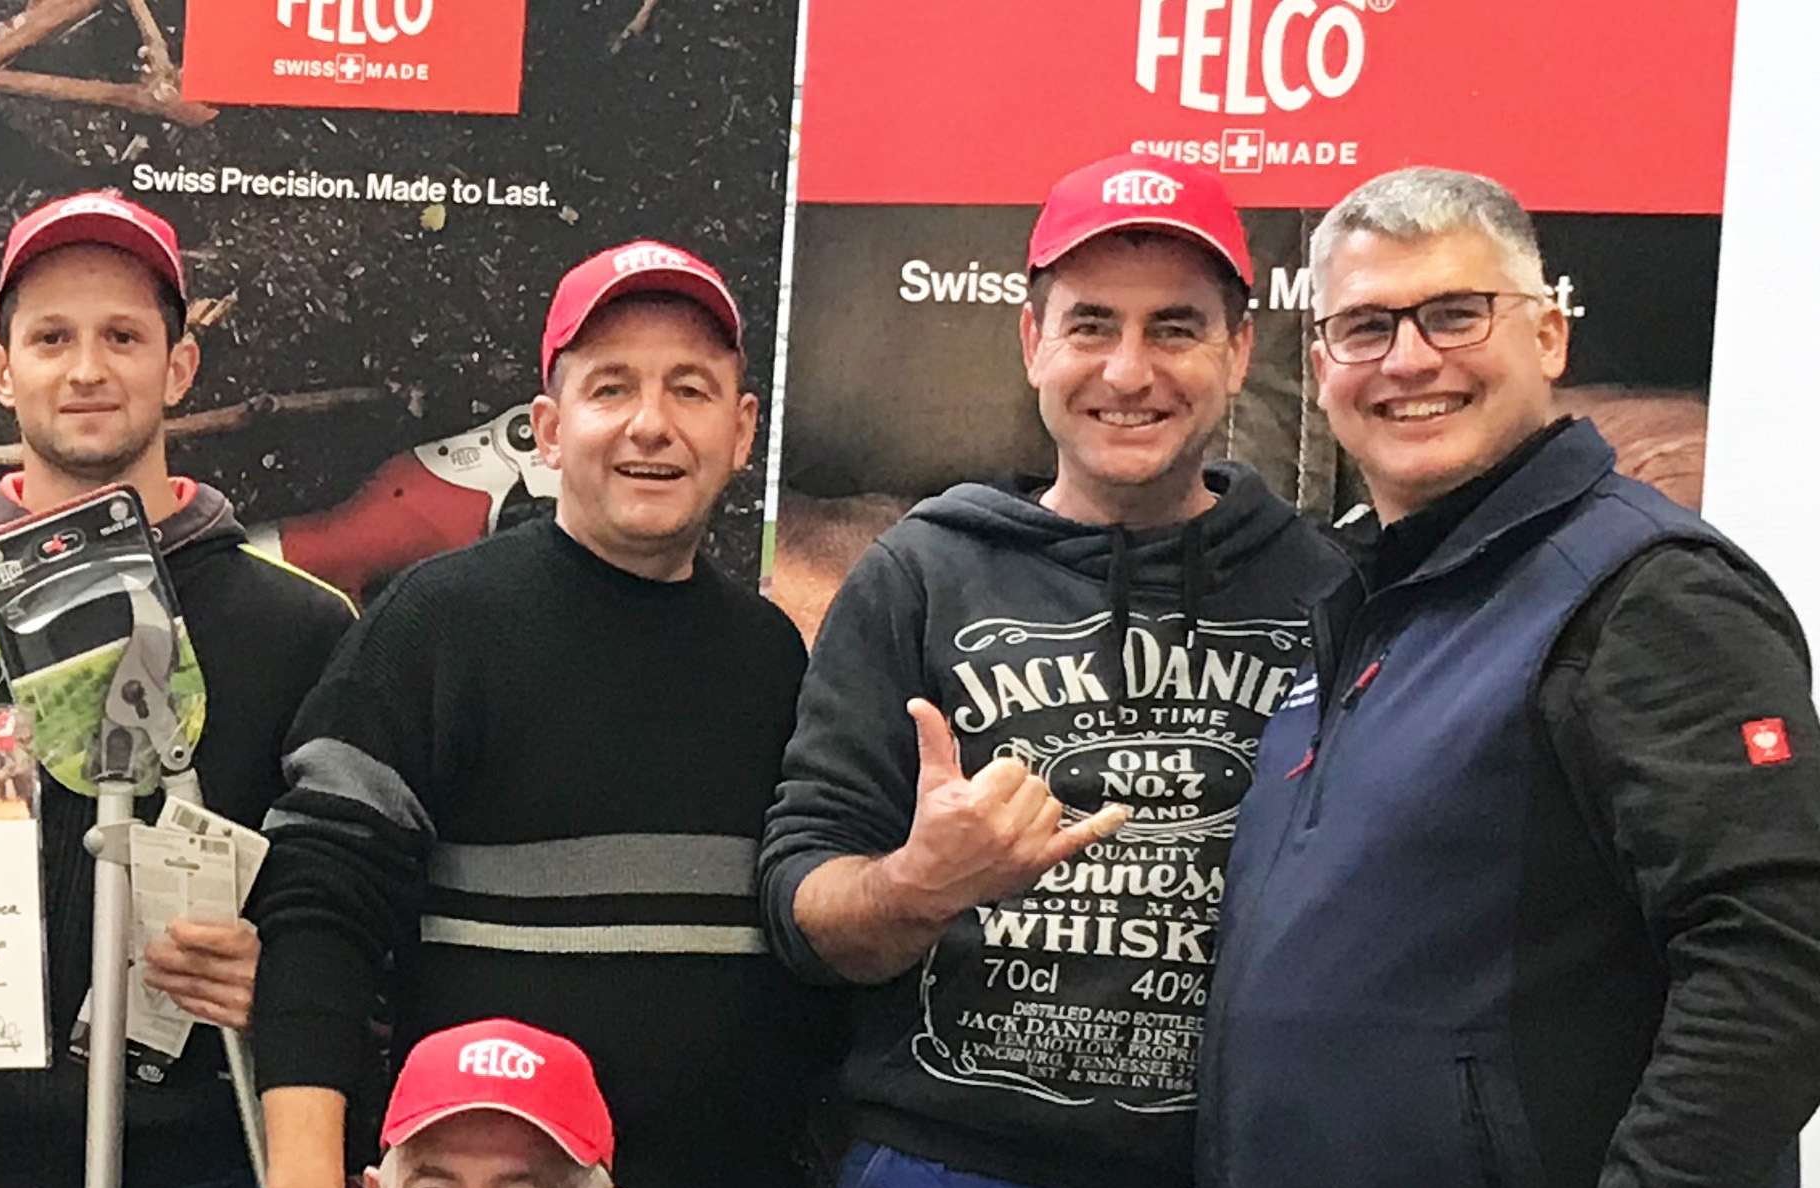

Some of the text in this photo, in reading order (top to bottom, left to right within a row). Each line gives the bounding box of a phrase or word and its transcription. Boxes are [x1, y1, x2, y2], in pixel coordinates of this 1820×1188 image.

[273, 59, 429, 80] SWISS MADE
[1130, 140, 1358, 165] SWISS MADE
[133, 163, 557, 207] Swiss Precision. Made to Last.
[1103, 170, 1184, 205] FELCO
[899, 260, 1028, 304] Swiss
[952, 651, 1110, 734] JACK
[1073, 704, 1230, 730] OLD TIME
[1107, 748, 1194, 773] Old
[1103, 800, 1199, 820] AND
[1084, 843, 1200, 862] QUALITY
[1034, 861, 1226, 904] enness
[1022, 897, 1119, 914] SOUR
[976, 906, 1217, 965] WHISK
[983, 958, 1208, 1006] 70cl 40%
[956, 1010, 1021, 1033] JACK
[1024, 1017, 1124, 1043] DANIEL
[1013, 1001, 1092, 1022] DISTILLED
[1093, 1008, 1130, 1026] AND
[458, 1040, 546, 1079] FELCO
